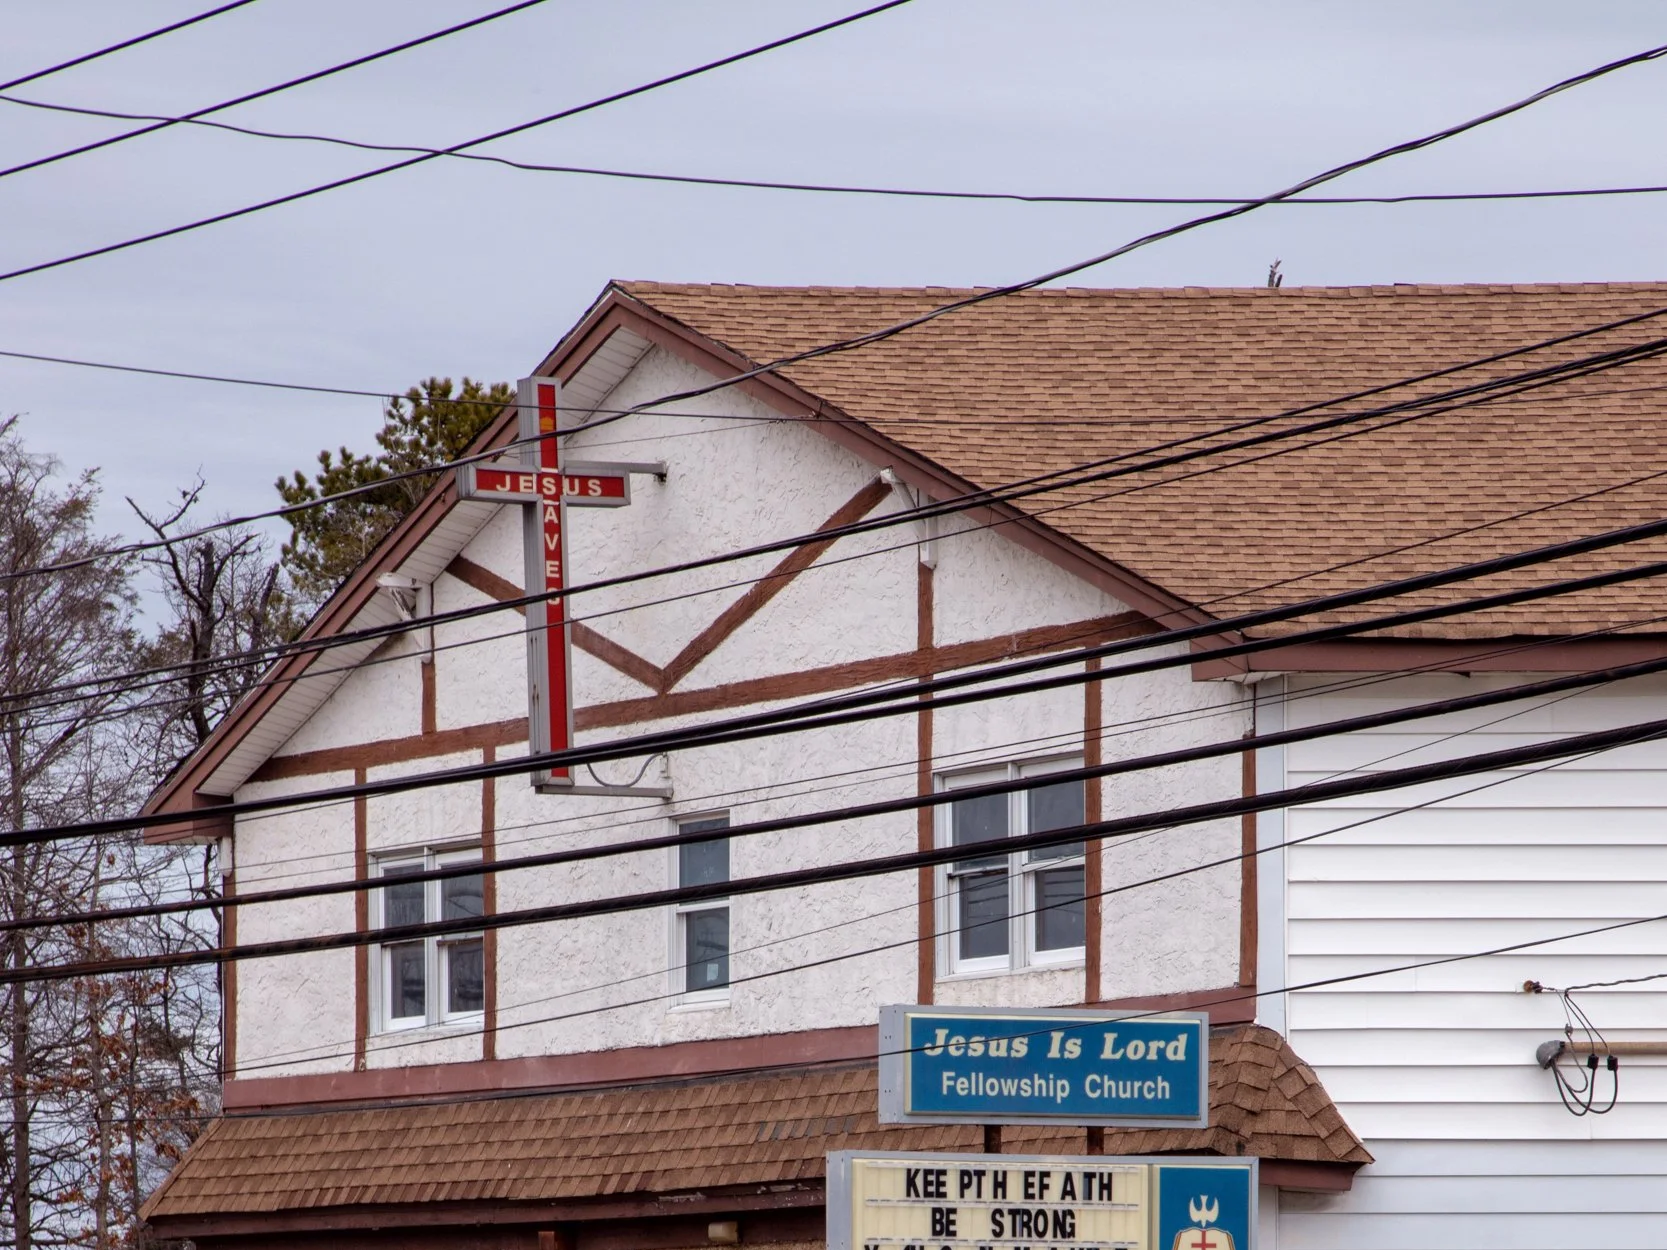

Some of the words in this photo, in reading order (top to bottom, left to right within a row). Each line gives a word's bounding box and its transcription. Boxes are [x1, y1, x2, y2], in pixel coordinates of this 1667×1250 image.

[496, 474, 602, 497] JESUS
[923, 1028, 1029, 1058] Jesus
[1047, 1031, 1083, 1059] Is
[1100, 1032, 1188, 1061] Lord
[942, 1071, 1071, 1104] Fellowship
[1085, 1074, 1171, 1099] Church
[931, 1207, 957, 1237] BE
[991, 1208, 1076, 1239] STRONG
